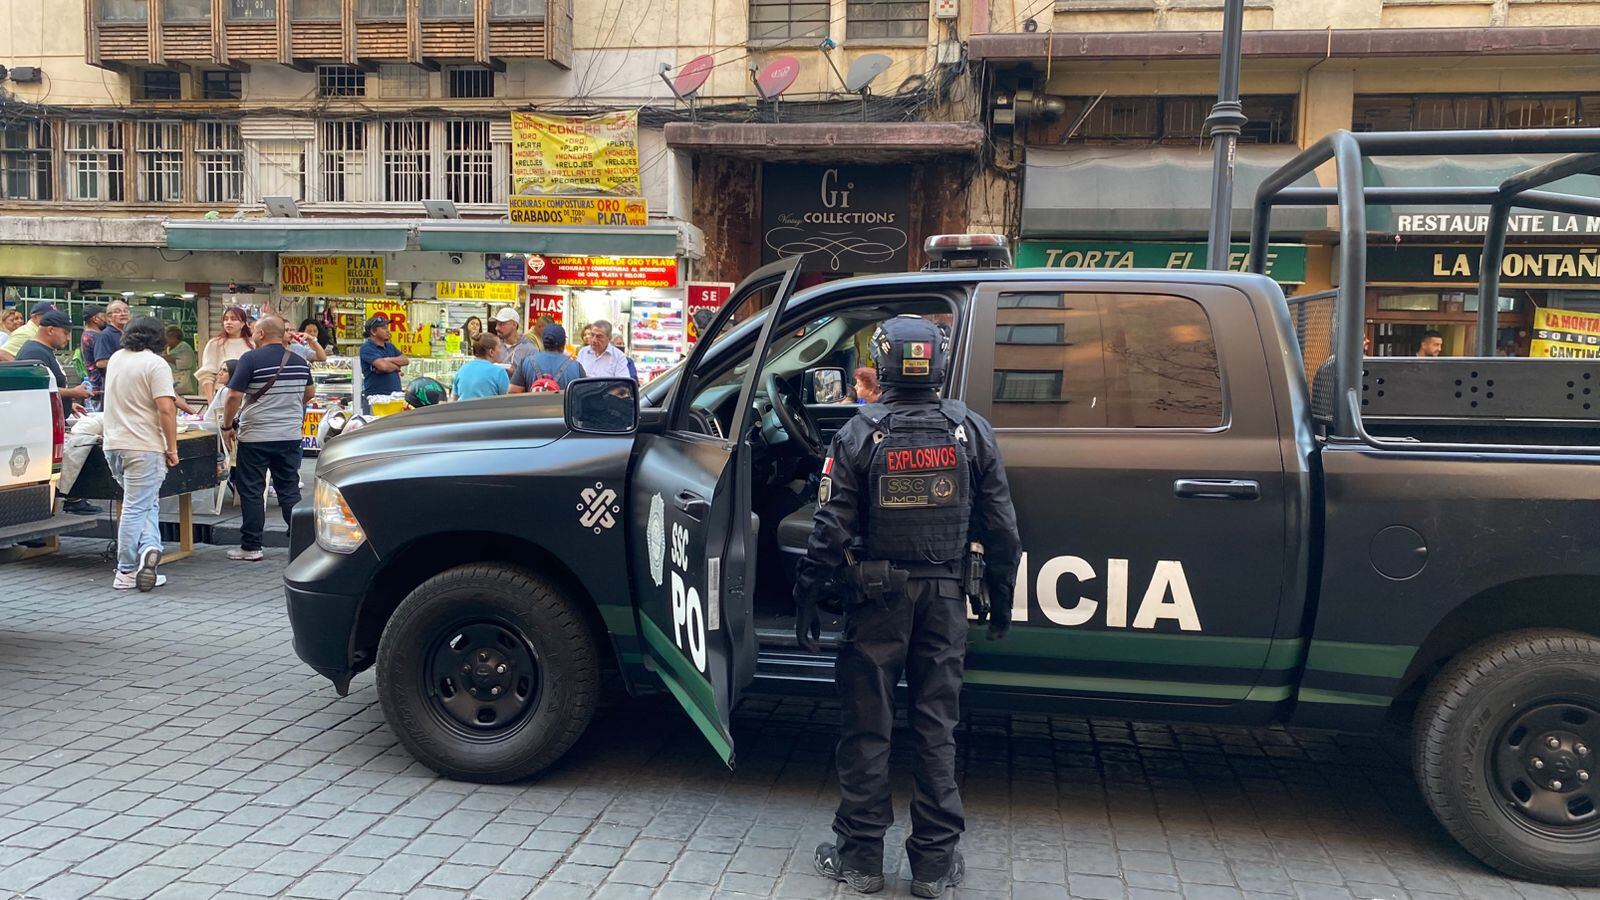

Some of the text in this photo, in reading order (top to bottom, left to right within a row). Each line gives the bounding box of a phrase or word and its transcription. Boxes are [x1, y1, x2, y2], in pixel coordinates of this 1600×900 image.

[548, 124, 601, 134] COMPRA
[510, 200, 541, 208] HECHURAS
[546, 200, 595, 209] COMPOSTURAS
[597, 200, 620, 211] ORO
[511, 210, 563, 222] GRABADOS
[597, 213, 628, 225] PLATA
[804, 212, 895, 224] COLLECTIONS
[1398, 215, 1545, 232] RESTAURNTE
[1552, 215, 1579, 232] LA
[347, 257, 378, 269] PLATA
[627, 258, 644, 266] ORO
[651, 258, 676, 266] PLATA
[1045, 249, 1135, 270] TORTA
[1433, 248, 1600, 277] LA ONTAÑ
[282, 265, 309, 284] ORO
[347, 269, 373, 278] RELOJES
[282, 284, 310, 292] MONEDAS
[348, 285, 381, 294] GRANALLA
[701, 290, 717, 301] SE
[1545, 311, 1559, 328] LA
[398, 333, 423, 343] PIEZA
[888, 447, 956, 470] EXPLOSIVOS
[888, 478, 925, 494] SSC
[671, 521, 689, 572] SSC
[671, 570, 706, 673] PO
